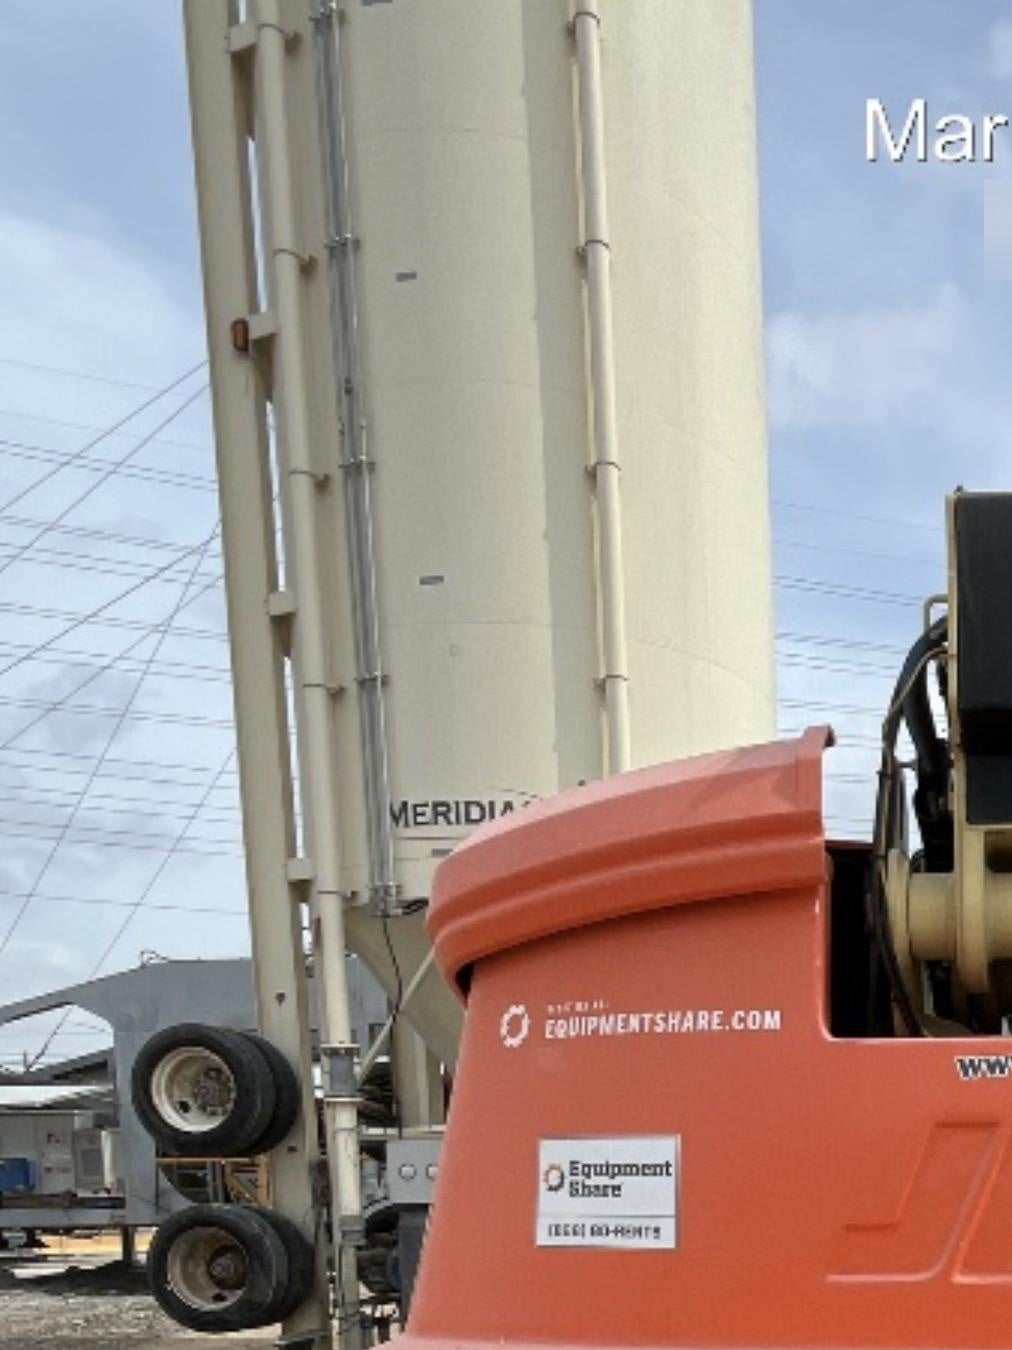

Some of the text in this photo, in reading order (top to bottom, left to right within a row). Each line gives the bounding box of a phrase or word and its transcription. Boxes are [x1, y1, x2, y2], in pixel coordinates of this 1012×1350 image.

[388, 799, 532, 830] MERIDIA
[544, 1010, 782, 1039] EQUIPMENTSHARE.COM
[568, 1160, 673, 1179] Equipment
[568, 1181, 623, 1198] Share
